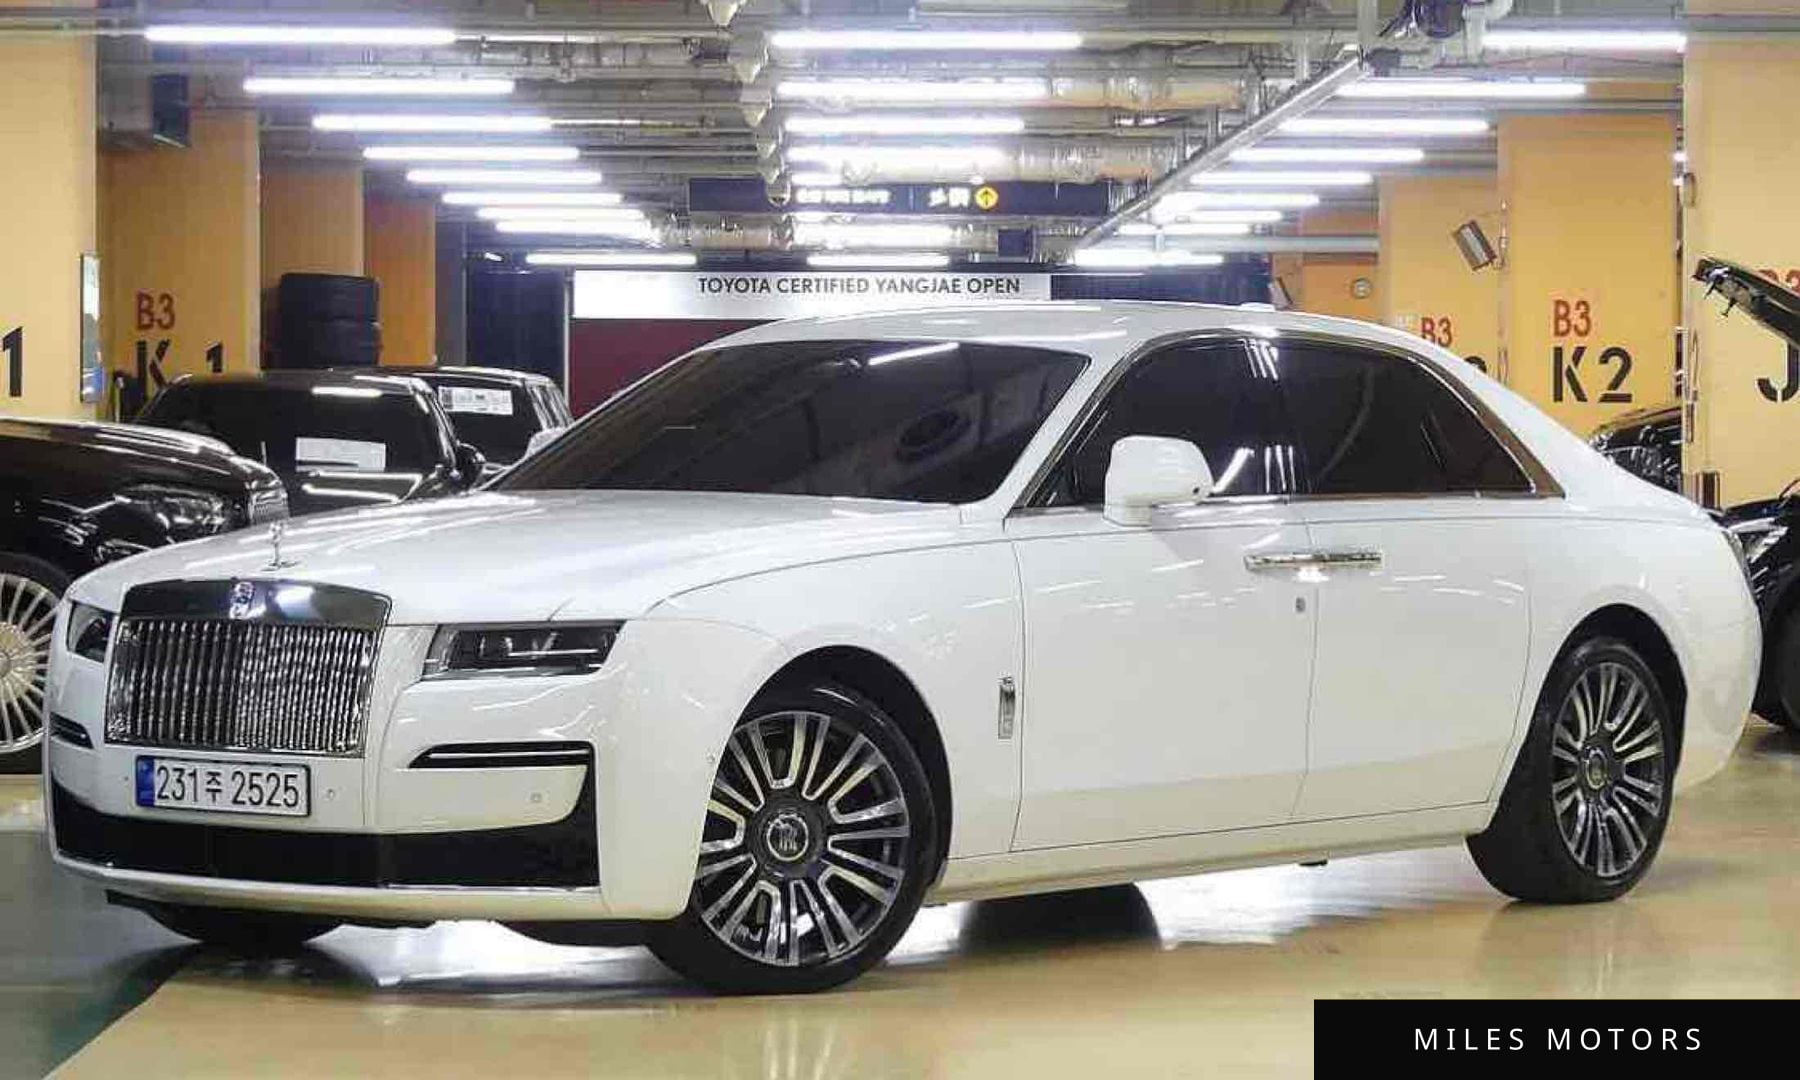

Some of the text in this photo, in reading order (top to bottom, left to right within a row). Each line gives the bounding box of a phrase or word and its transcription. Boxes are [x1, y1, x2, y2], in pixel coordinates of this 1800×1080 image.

[699, 277, 1020, 293] TOYOTA CERTIFIED YANGJAE OPEN
[136, 292, 176, 331] B3
[1553, 300, 1591, 337] B3
[1421, 317, 1452, 348] B3
[230, 770, 299, 808] 2525
